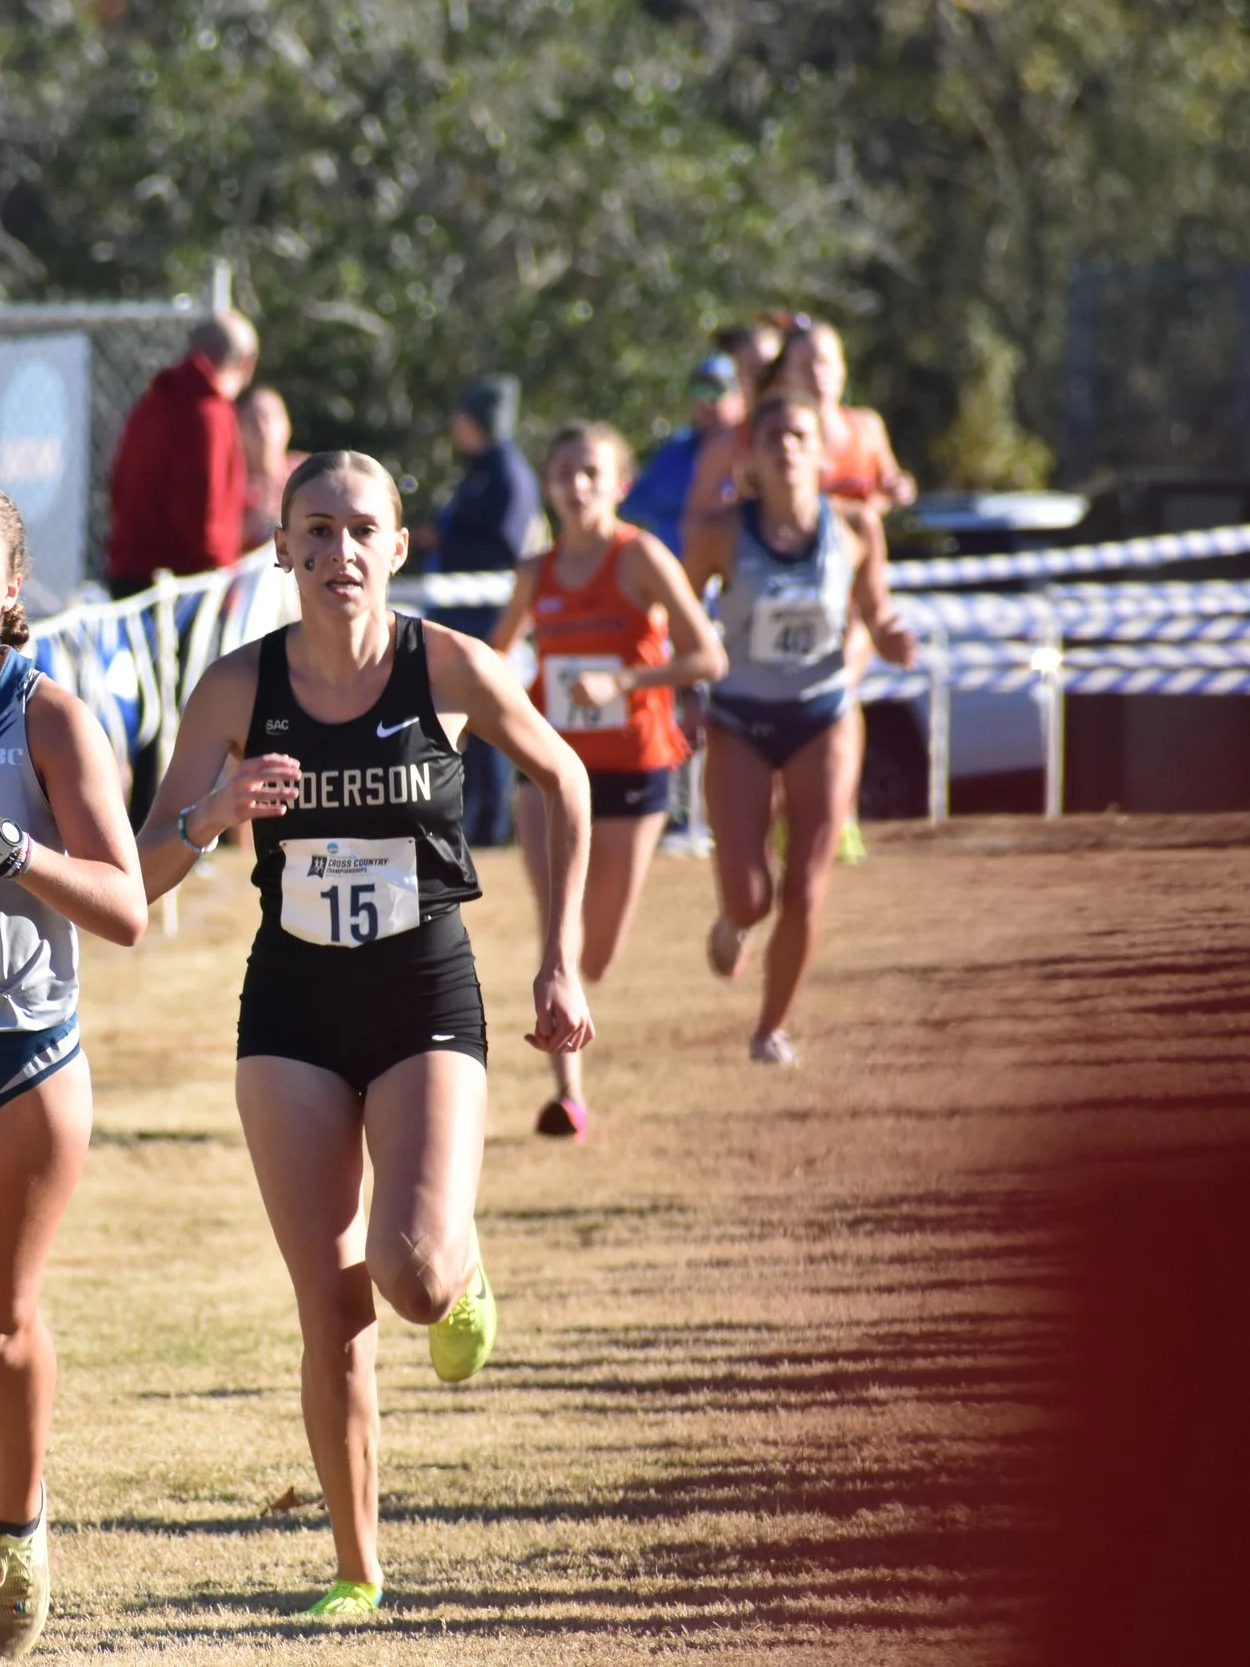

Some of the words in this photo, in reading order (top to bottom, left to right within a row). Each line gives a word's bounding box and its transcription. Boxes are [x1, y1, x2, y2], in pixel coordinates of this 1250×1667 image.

[265, 719, 290, 732] SAC
[257, 762, 432, 810] DERSON
[328, 858, 352, 868] CROSS
[354, 857, 389, 867] COUNTRY
[320, 883, 378, 943] 15
